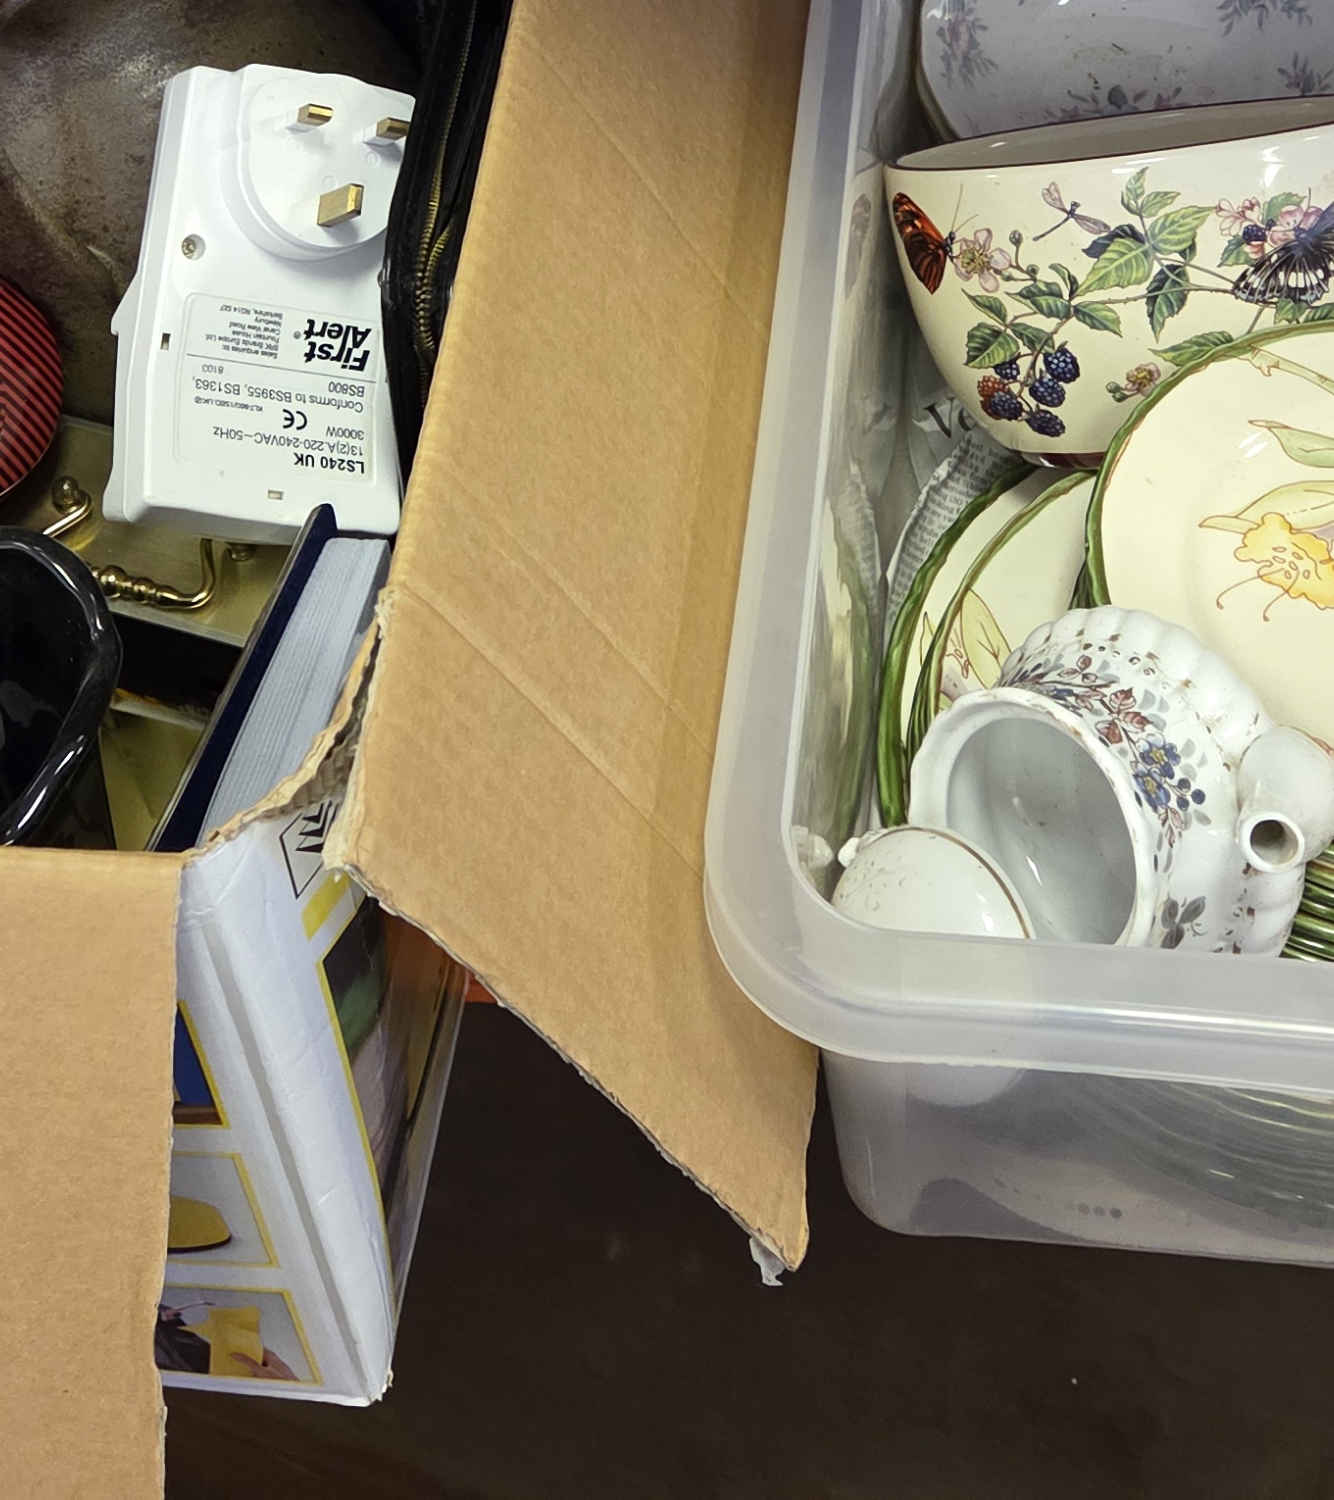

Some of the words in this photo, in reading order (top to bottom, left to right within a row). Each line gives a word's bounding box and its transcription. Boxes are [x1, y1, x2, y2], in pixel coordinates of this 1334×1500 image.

[254, 317, 282, 327] Newbury
[232, 330, 251, 339] House
[303, 319, 372, 348] Alert
[304, 341, 370, 371] First
[202, 364, 224, 374] 8103
[192, 376, 240, 395] BS1363,
[244, 384, 292, 402] BS3955,
[328, 381, 365, 397] BS800
[295, 393, 306, 404] to
[309, 394, 363, 413] Conforms
[326, 426, 364, 440] 3000W
[293, 453, 314, 467] UK
[320, 456, 365, 473] LS240
